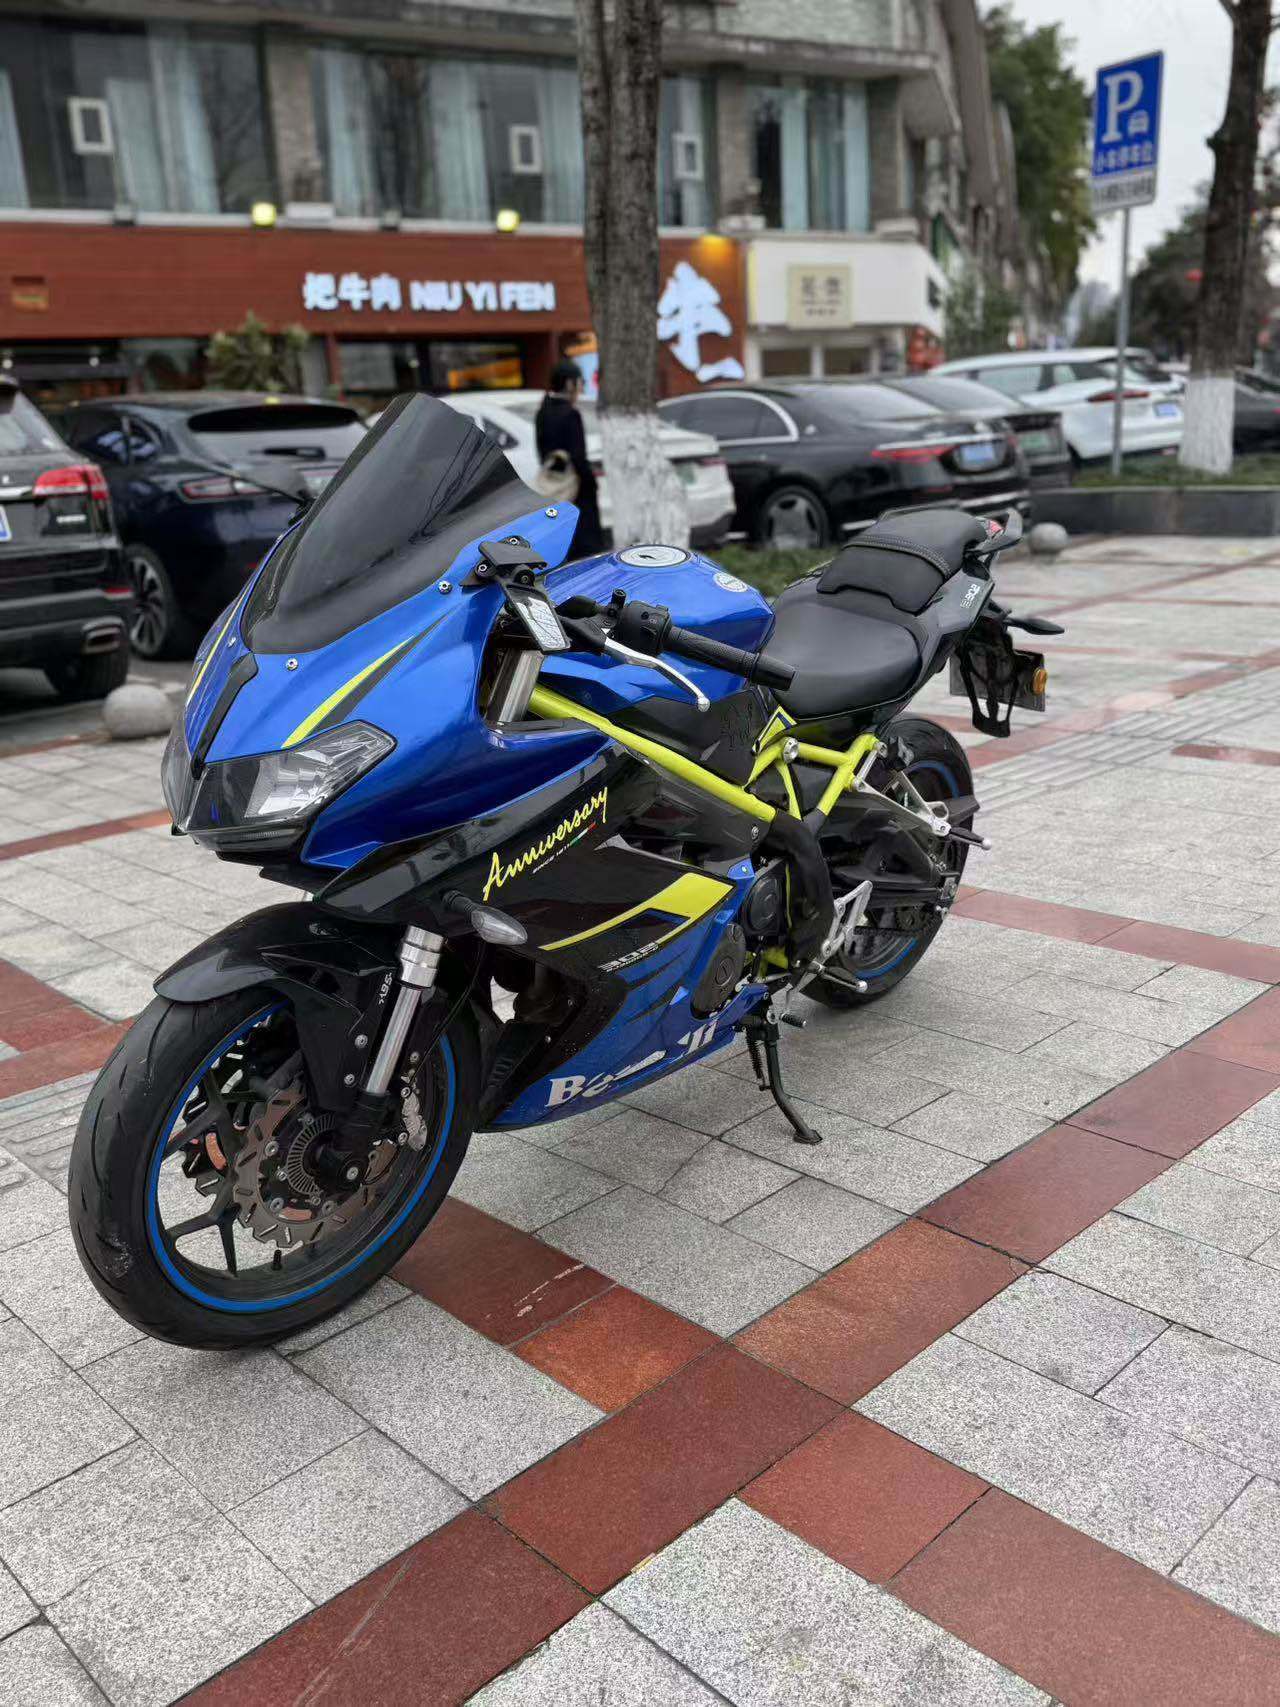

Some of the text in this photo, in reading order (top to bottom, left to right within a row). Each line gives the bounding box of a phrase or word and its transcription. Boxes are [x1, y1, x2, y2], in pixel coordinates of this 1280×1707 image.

[1102, 70, 1144, 143] P
[410, 281, 461, 311] NIU
[464, 281, 498, 311] YI
[499, 281, 556, 311] FEN
[483, 787, 607, 901] Anniversary
